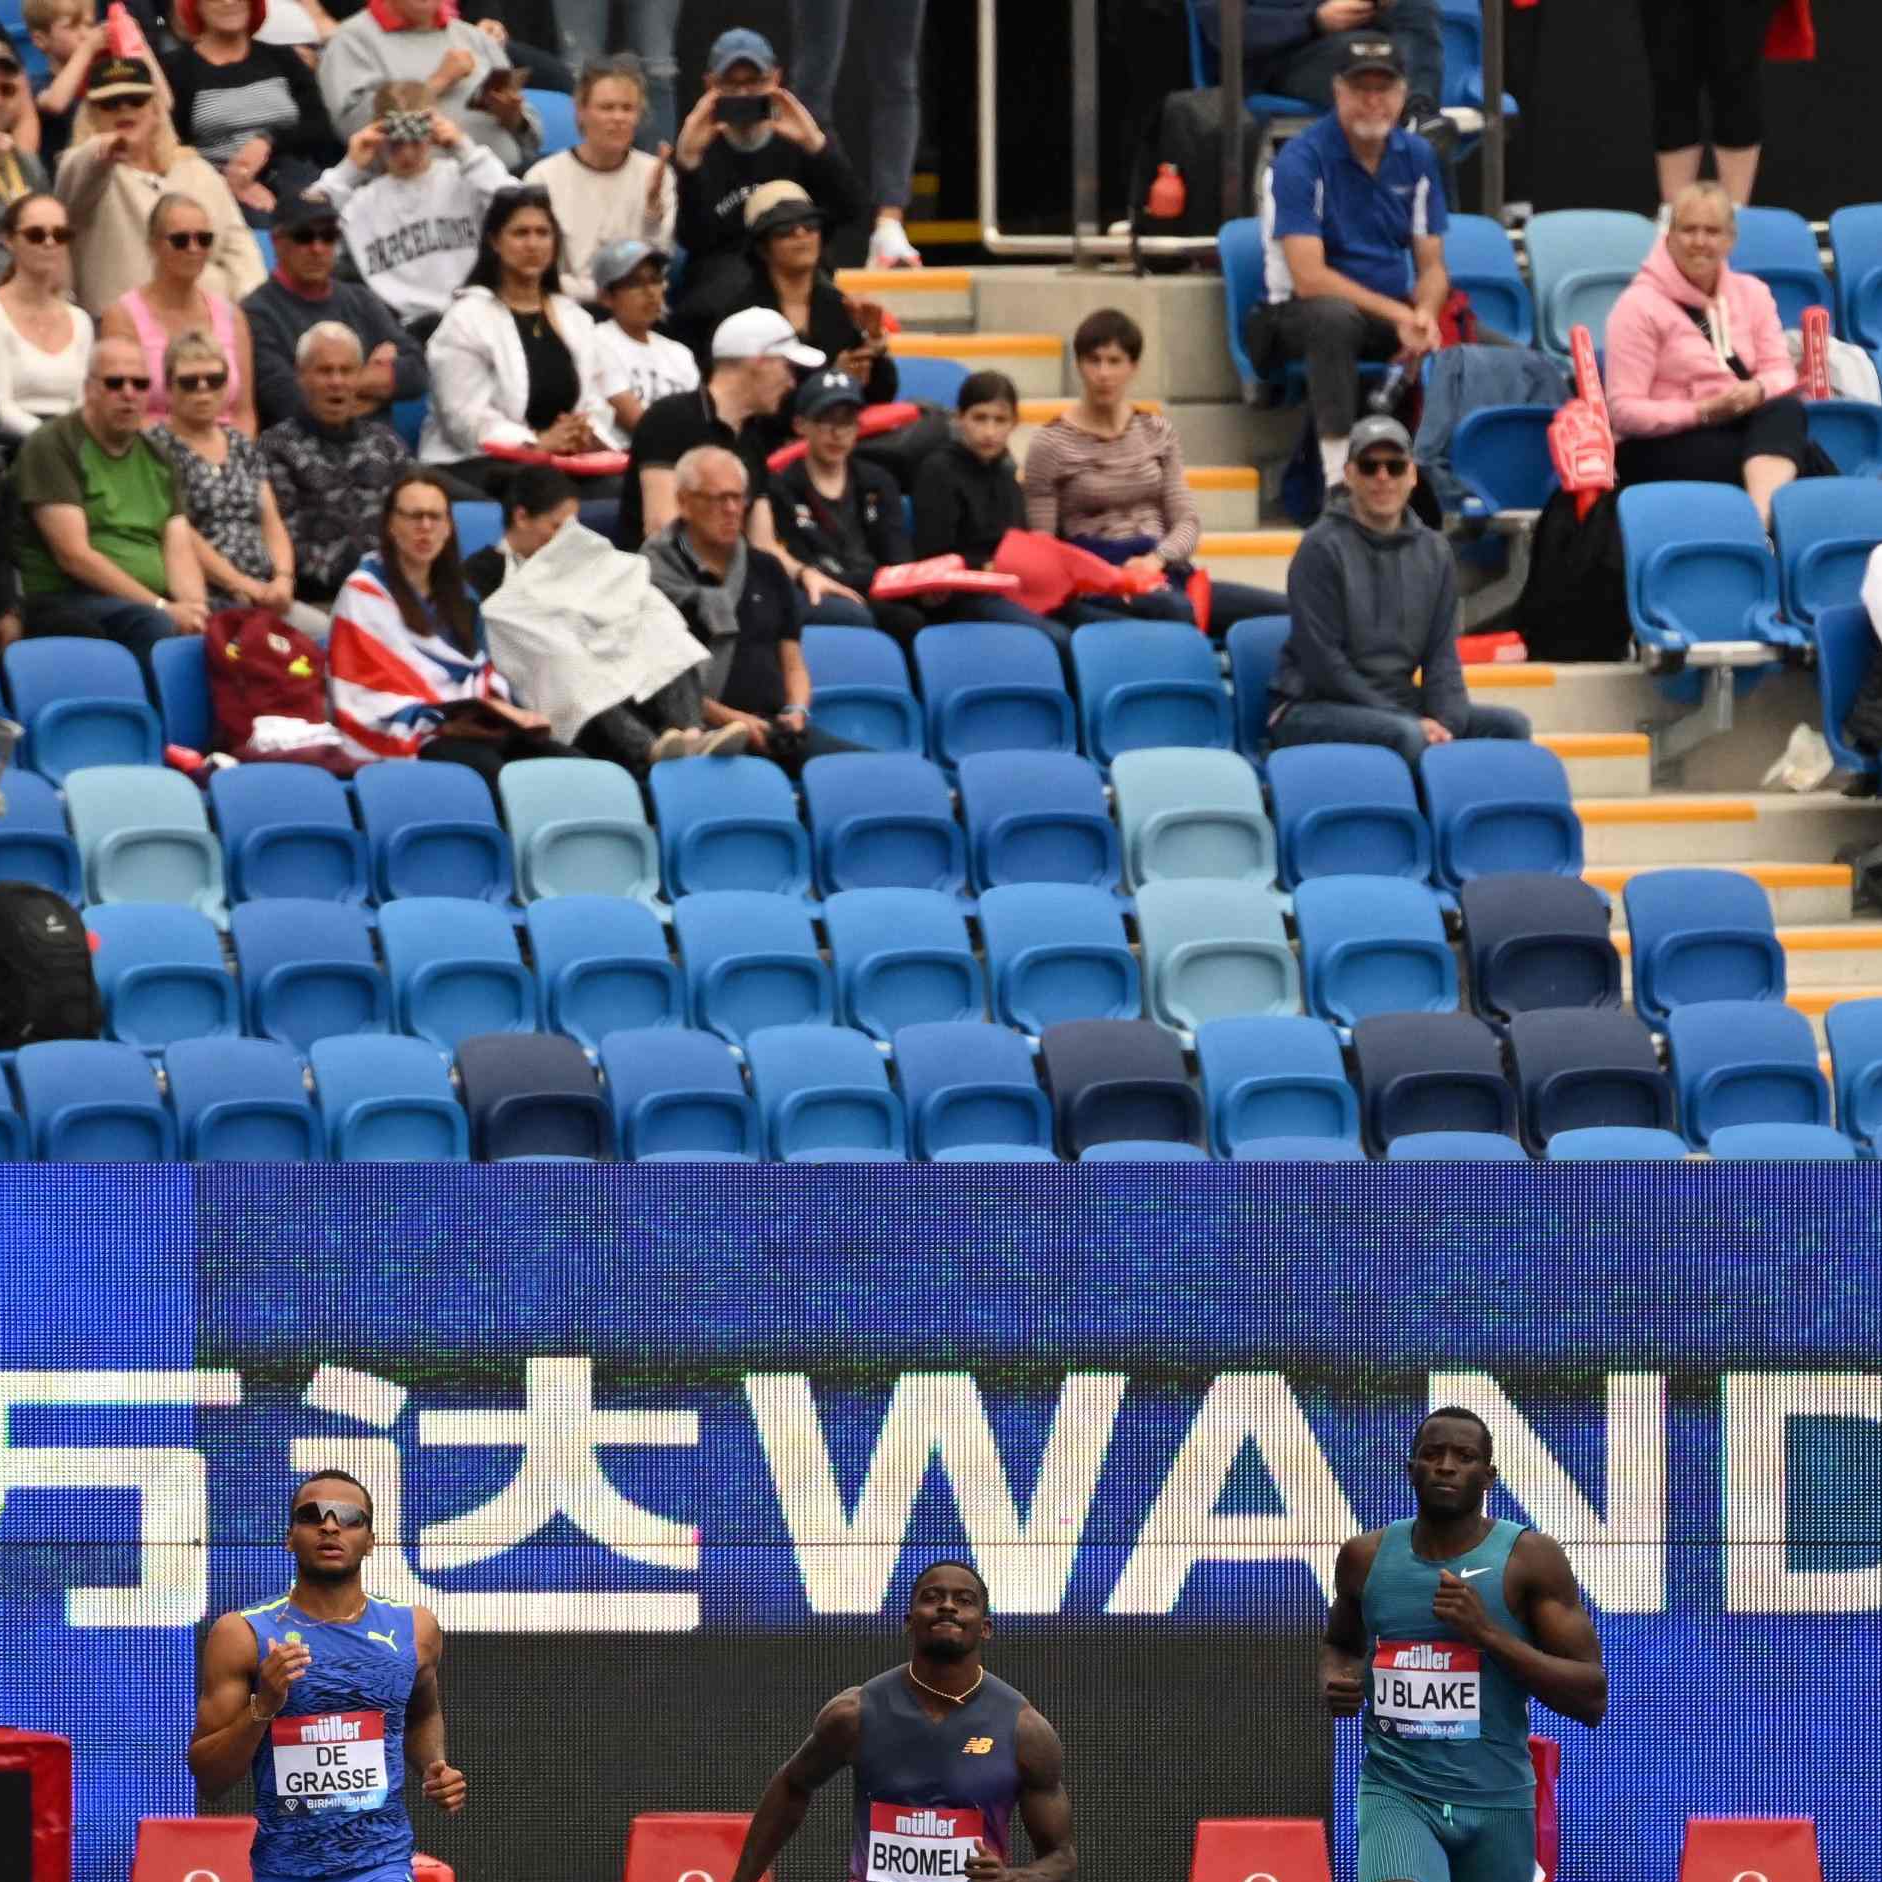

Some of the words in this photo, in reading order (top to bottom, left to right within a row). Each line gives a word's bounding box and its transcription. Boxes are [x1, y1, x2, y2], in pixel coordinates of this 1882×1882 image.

[1393, 1645, 1452, 1670] müller
[1378, 1678, 1387, 1704] J
[1393, 1680, 1476, 1709] BLAKE
[301, 1716, 361, 1742] müller
[1396, 1722, 1464, 1736] BIRMINGHAM
[317, 1745, 347, 1766] DE
[286, 1768, 378, 1792] GRASSE
[307, 1795, 377, 1809] BIRMINGHAM
[896, 1811, 956, 1836] müller
